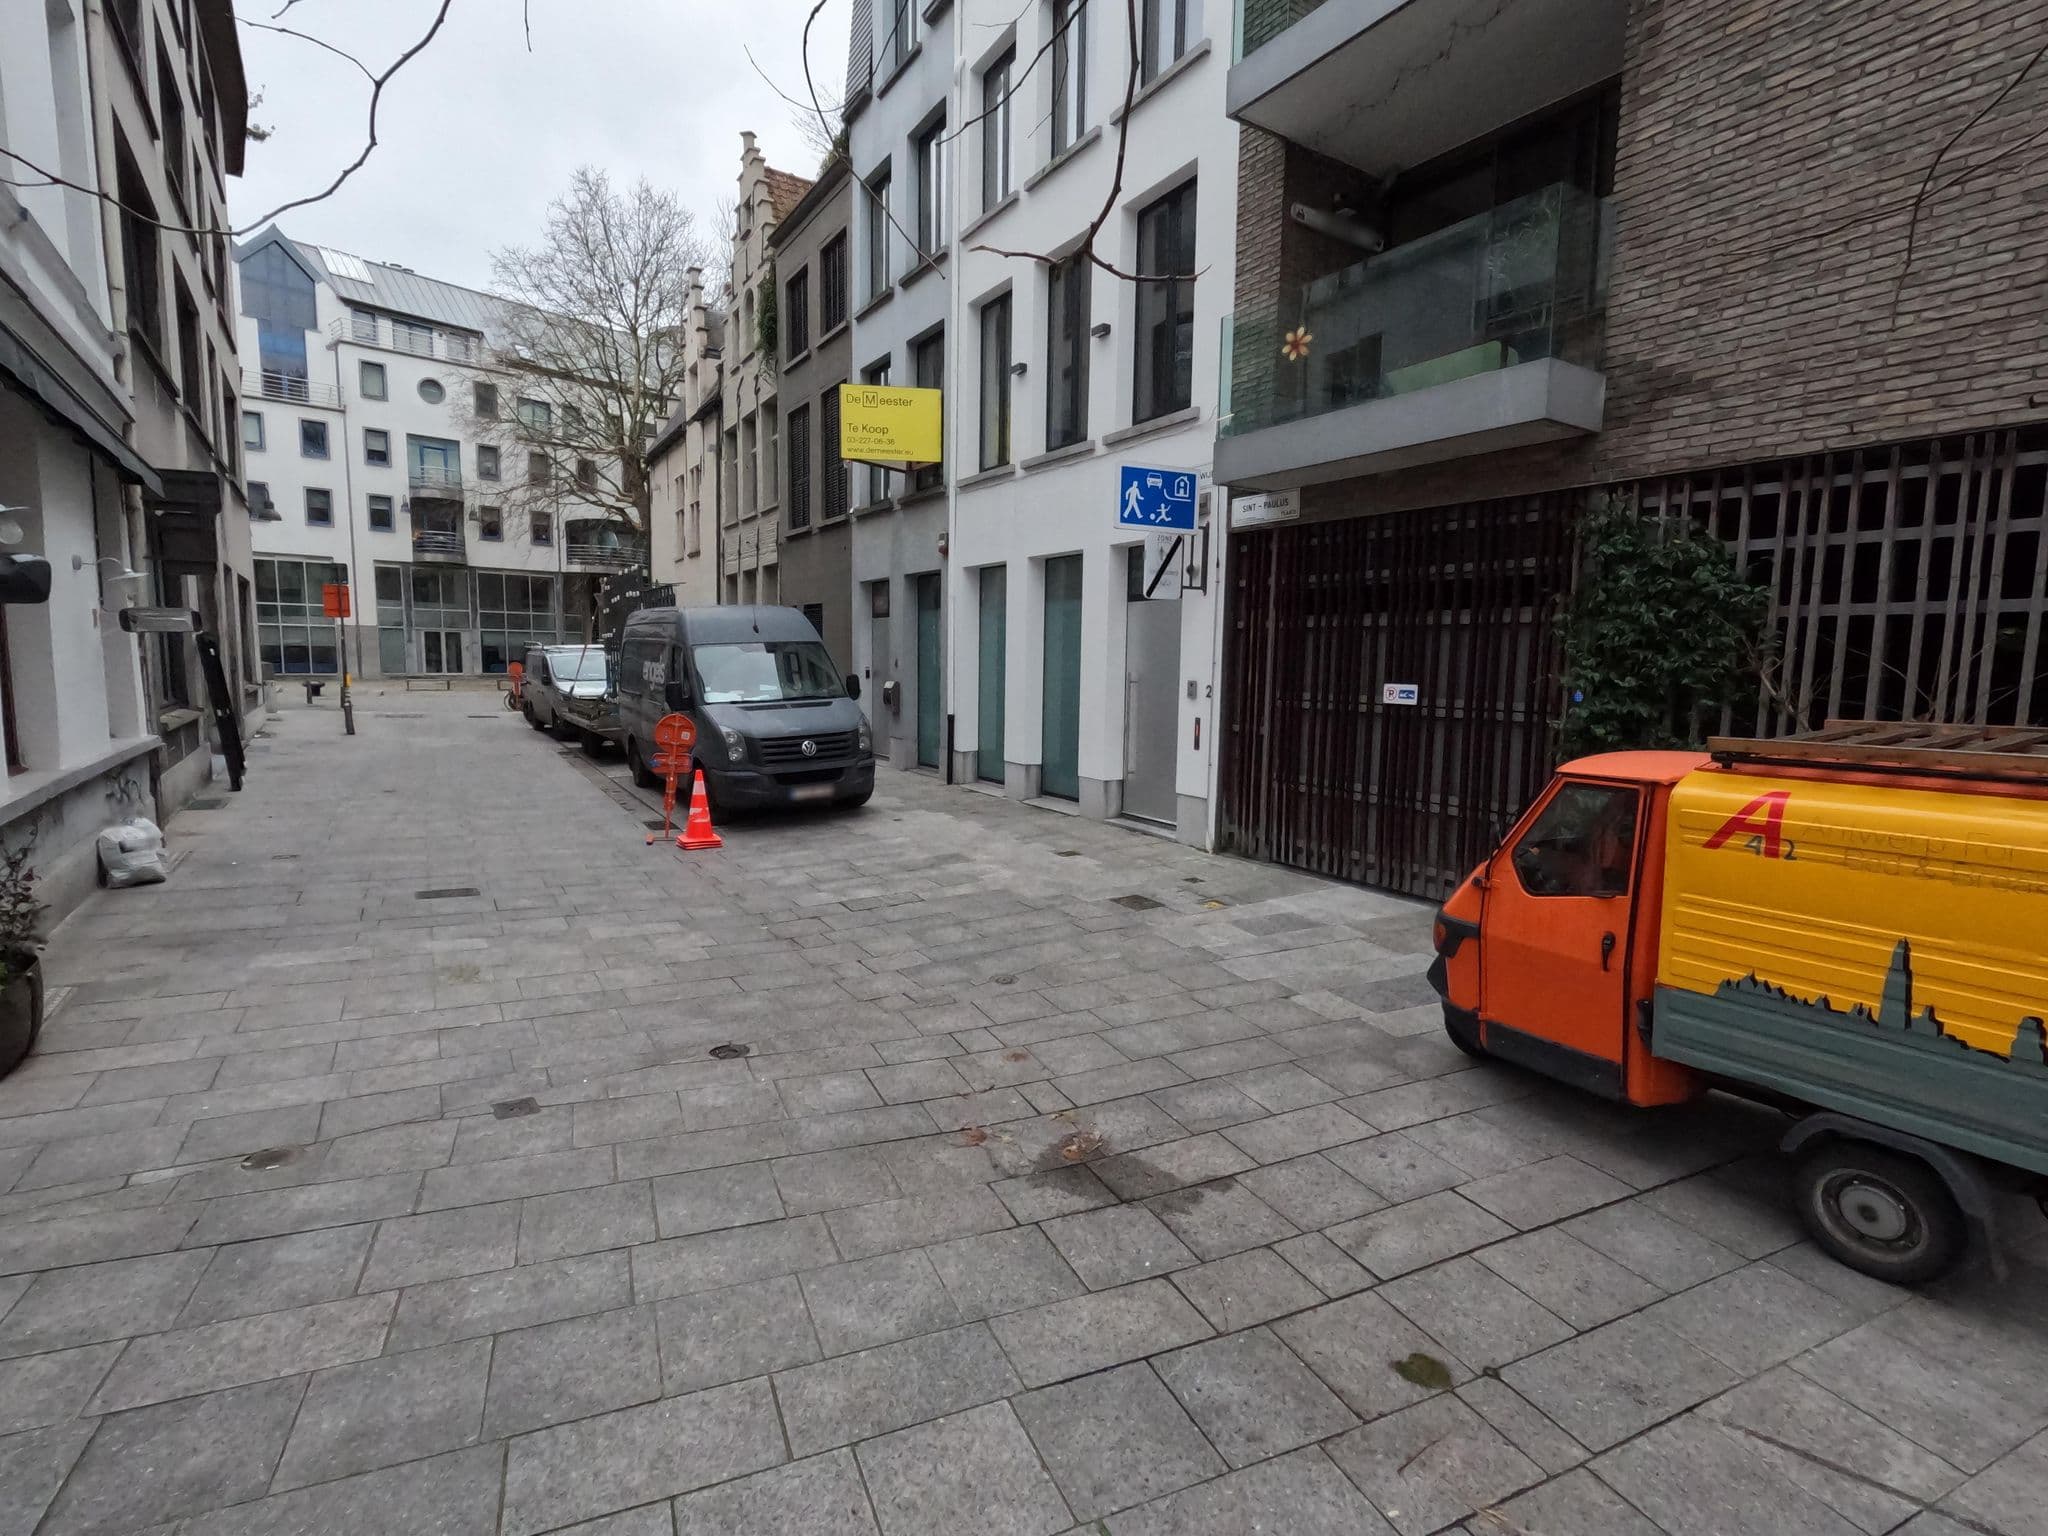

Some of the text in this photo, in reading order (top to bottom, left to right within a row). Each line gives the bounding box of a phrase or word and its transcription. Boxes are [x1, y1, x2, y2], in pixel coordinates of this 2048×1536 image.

[846, 391, 914, 408] De Meester
[846, 423, 889, 436] Te Koop
[1242, 503, 1257, 513] SINT
[1263, 497, 1289, 509] PAULUS
[1156, 534, 1173, 542] ZONE
[1205, 685, 1212, 698] 2
[1702, 791, 1791, 858] A
